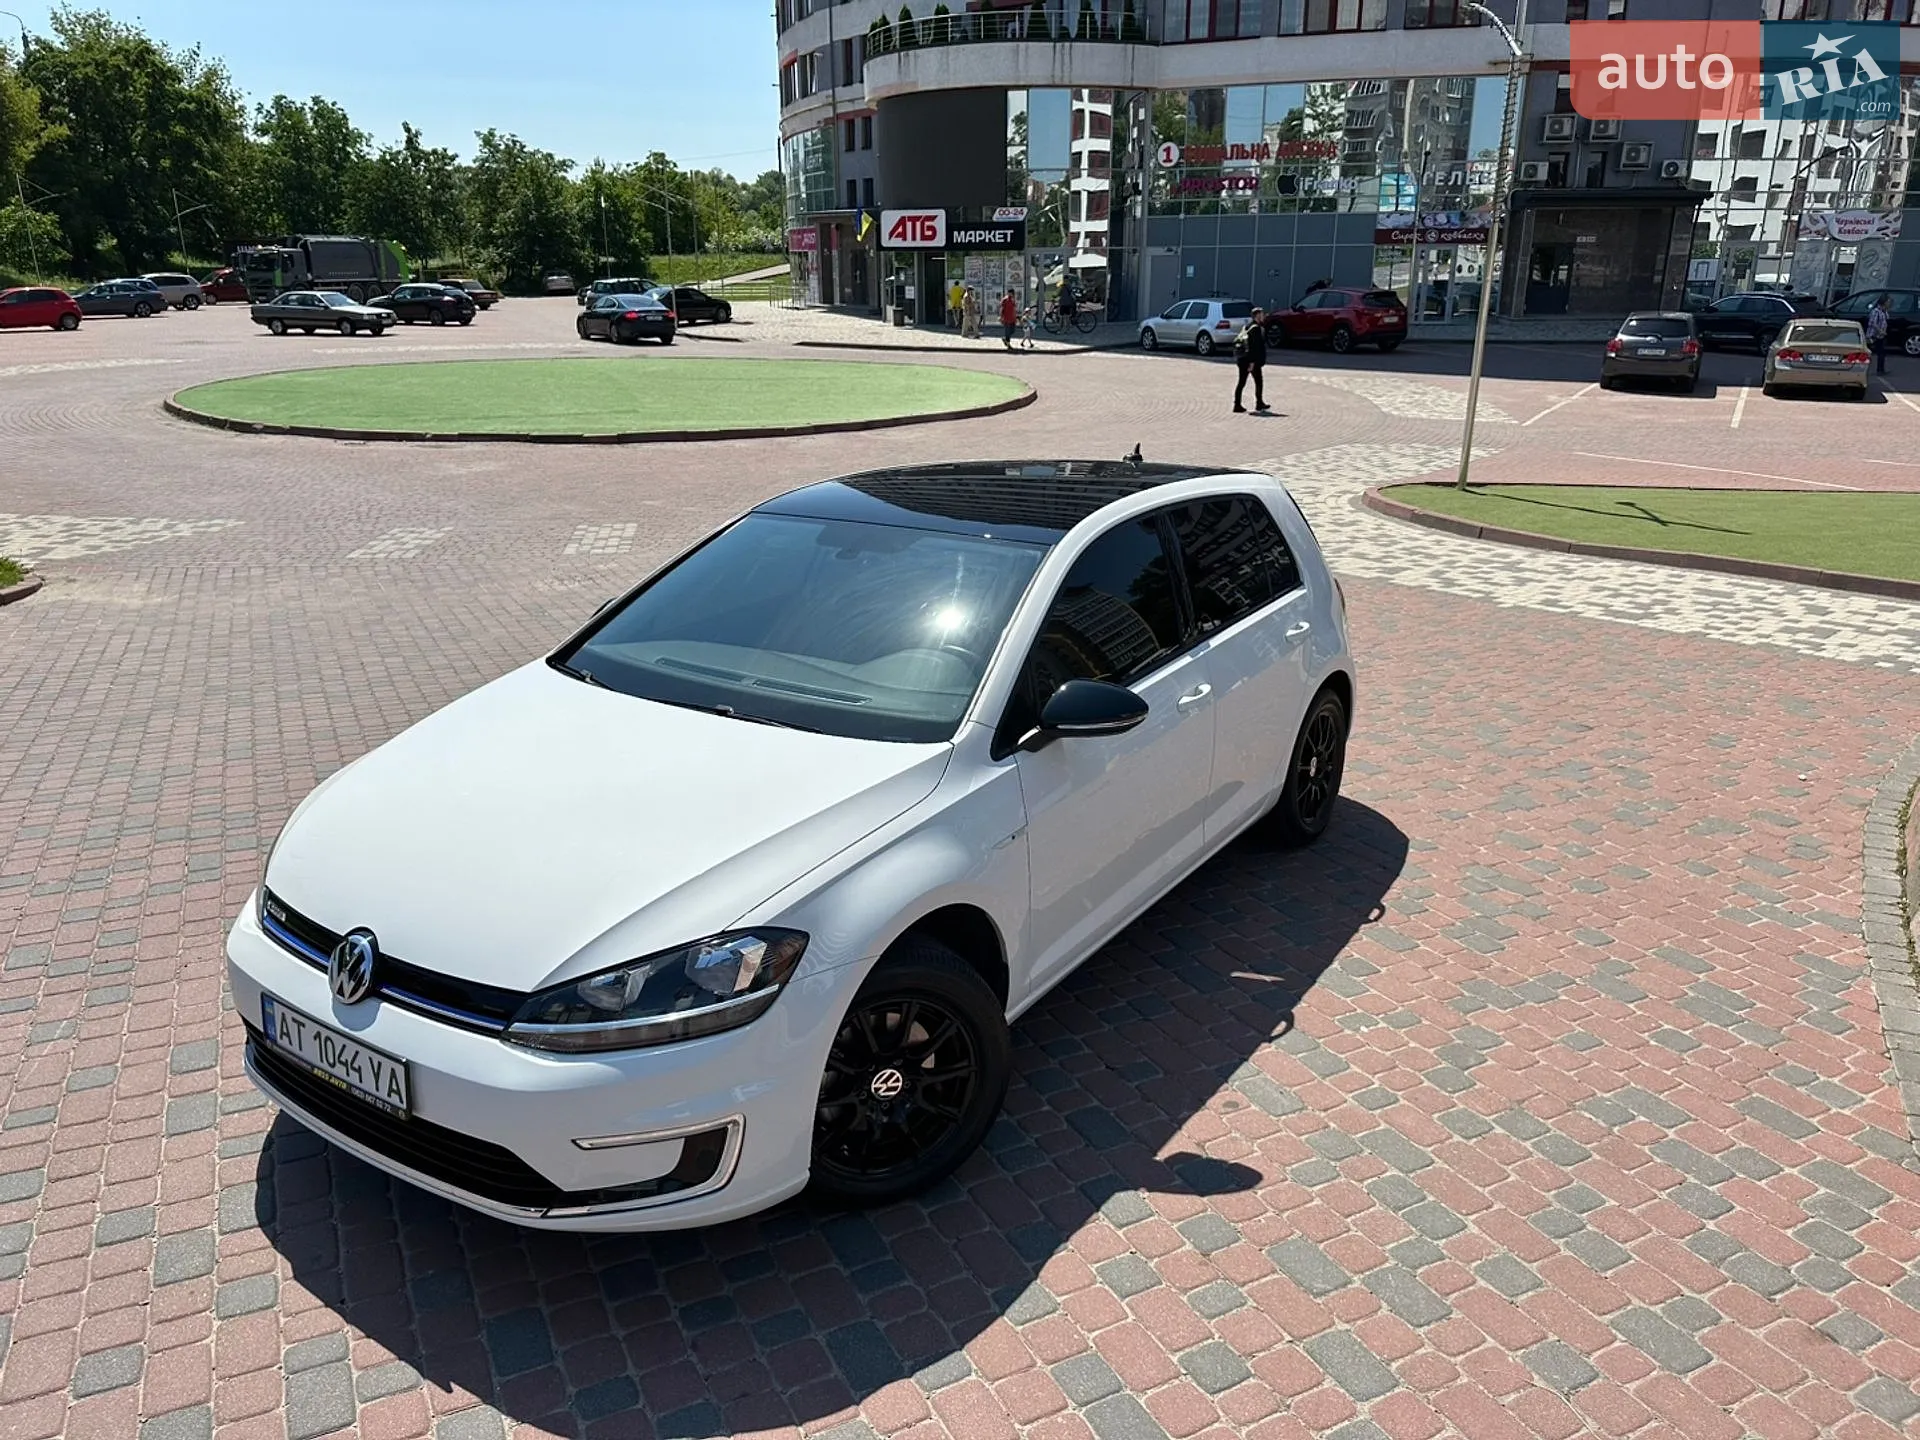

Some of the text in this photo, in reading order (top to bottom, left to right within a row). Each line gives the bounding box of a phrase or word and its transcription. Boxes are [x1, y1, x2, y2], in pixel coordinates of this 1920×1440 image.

[888, 215, 1014, 243] АТБ МАРКЕТ
[279, 1012, 306, 1052] AT
[313, 1030, 363, 1084] 1044
[368, 1055, 404, 1106] YA
